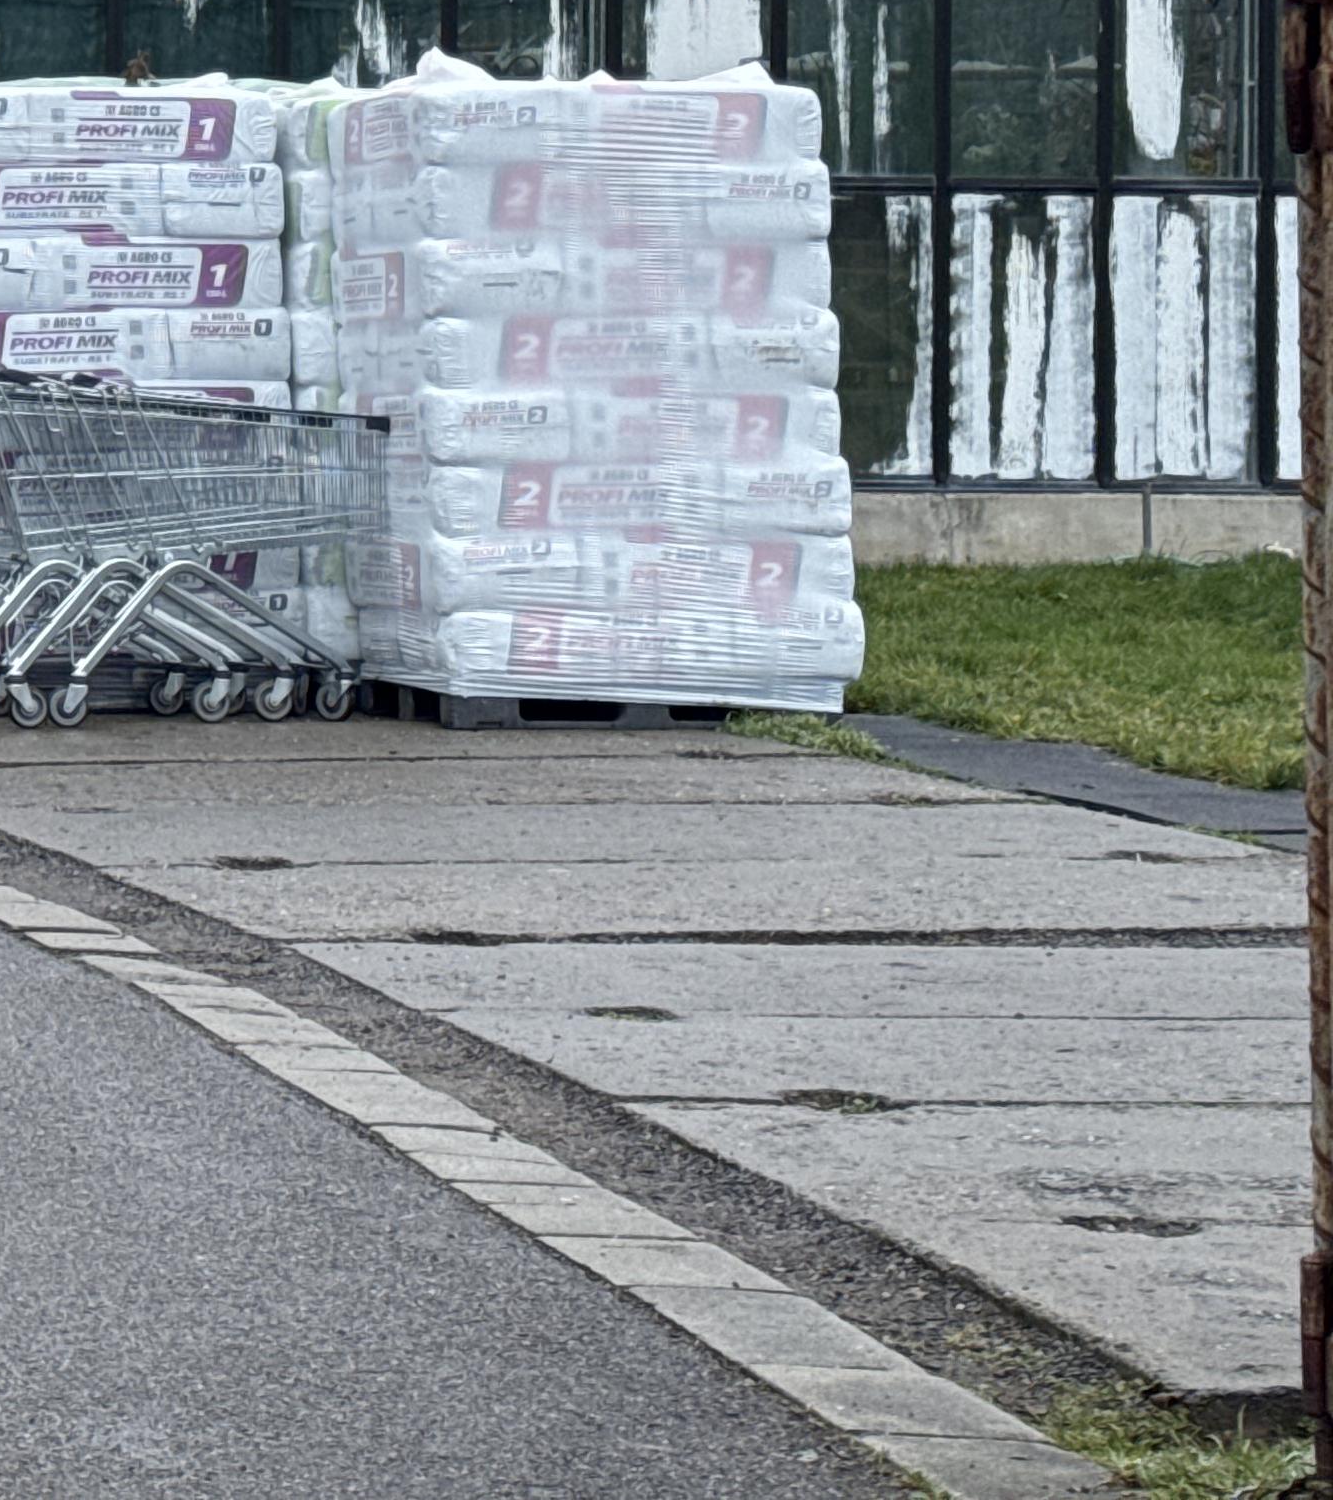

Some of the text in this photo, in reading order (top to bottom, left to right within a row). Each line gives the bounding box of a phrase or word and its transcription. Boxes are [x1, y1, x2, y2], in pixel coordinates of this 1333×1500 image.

[522, 109, 532, 122] 2
[75, 123, 183, 139] PROFI MIX
[199, 117, 216, 141] 1
[349, 122, 360, 143] 2
[2, 190, 109, 205] PROFI MIX
[504, 182, 533, 207] 2
[87, 270, 192, 285] PROFI MIX
[210, 263, 228, 288] 1
[387, 274, 398, 298] 2
[190, 324, 226, 334] PROFI
[228, 324, 252, 333] MIX
[9, 334, 118, 351] PROFI MIX
[513, 333, 541, 359] 2
[532, 408, 543, 423] 2
[746, 415, 770, 439] 2
[513, 480, 542, 506] 2
[758, 561, 783, 587] 2
[526, 627, 551, 651] 2
